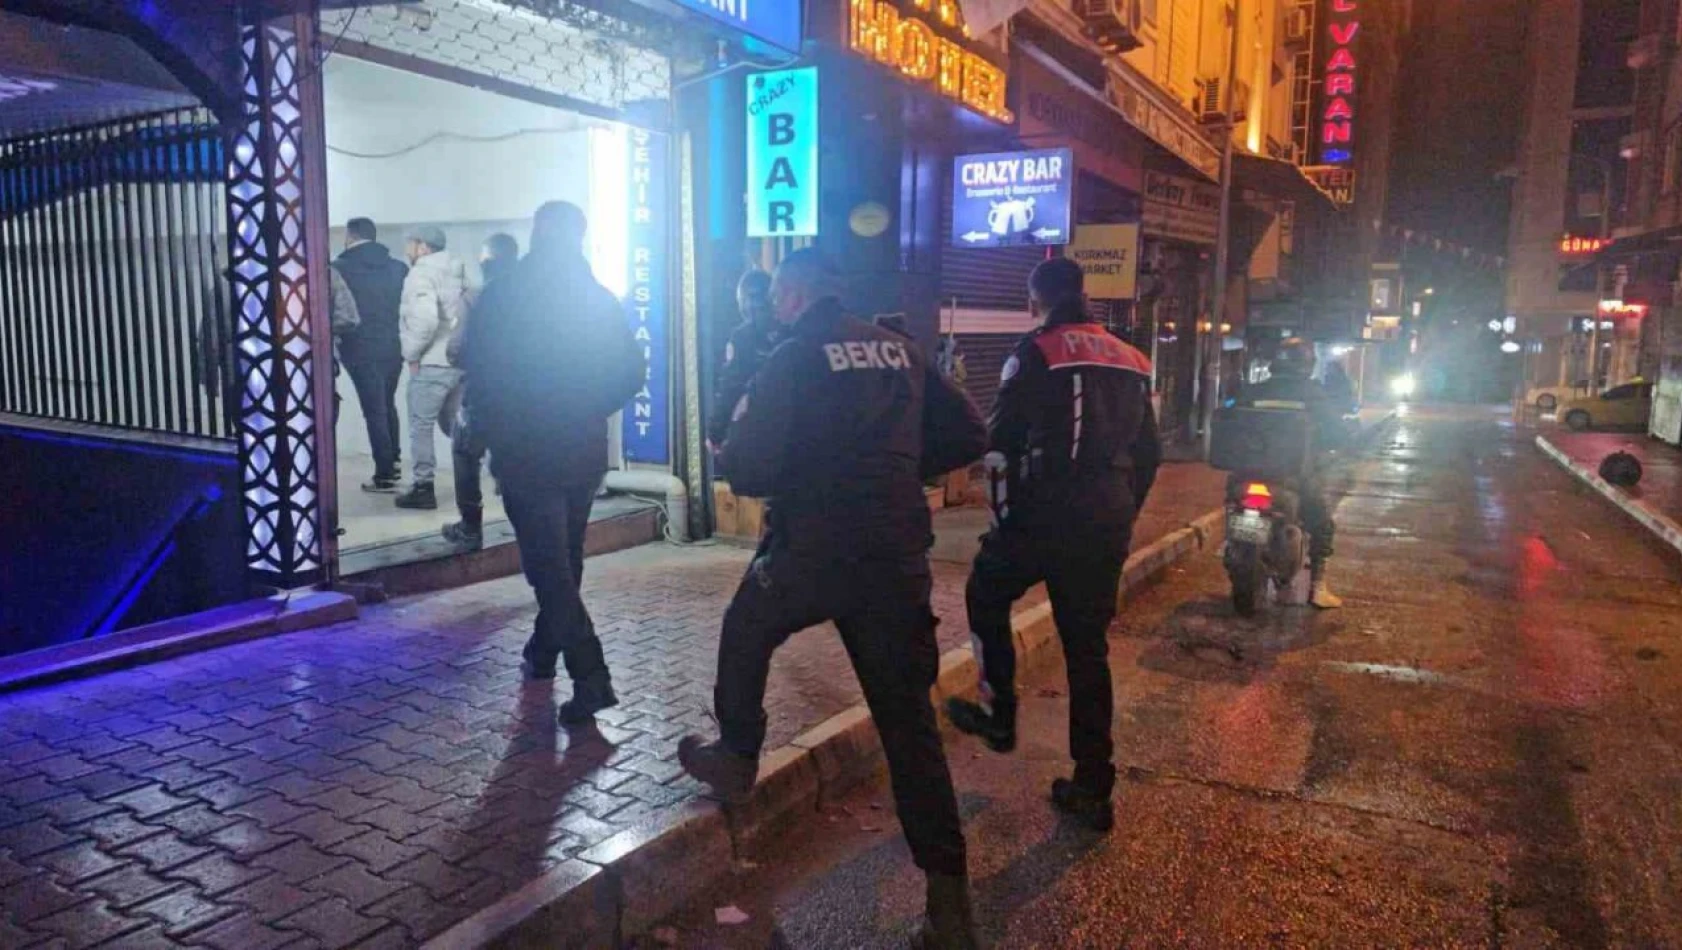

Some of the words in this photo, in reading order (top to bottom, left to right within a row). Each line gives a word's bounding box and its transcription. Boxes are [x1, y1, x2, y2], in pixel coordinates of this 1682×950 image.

[749, 74, 797, 117] CRAZY
[764, 112, 799, 233] BAR
[962, 160, 1020, 186] CRAZY
[1023, 156, 1062, 182] BAR
